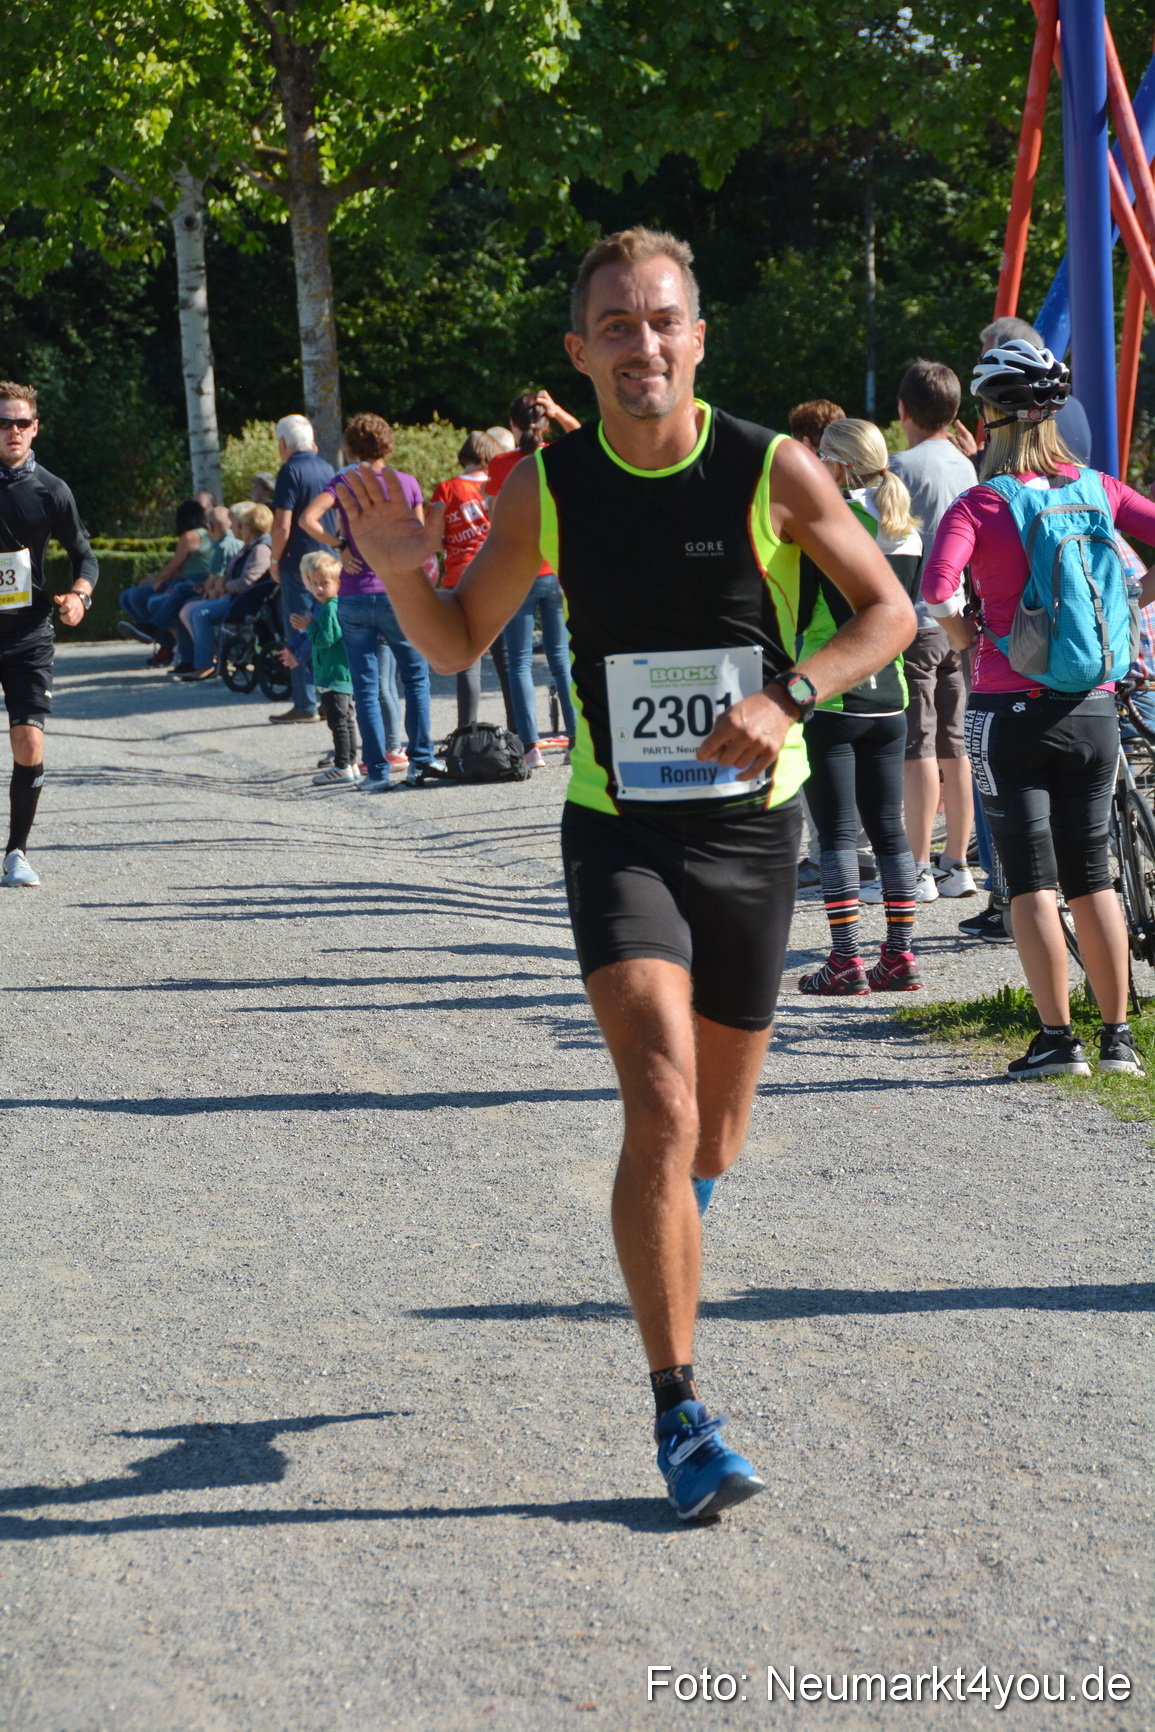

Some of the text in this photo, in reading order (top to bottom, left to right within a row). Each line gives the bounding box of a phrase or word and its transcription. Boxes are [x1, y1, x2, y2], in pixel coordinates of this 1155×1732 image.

[685, 541, 724, 551] GORE
[650, 665, 718, 683] BOCK
[643, 747, 674, 755] PARTL
[660, 766, 718, 785] Ronny
